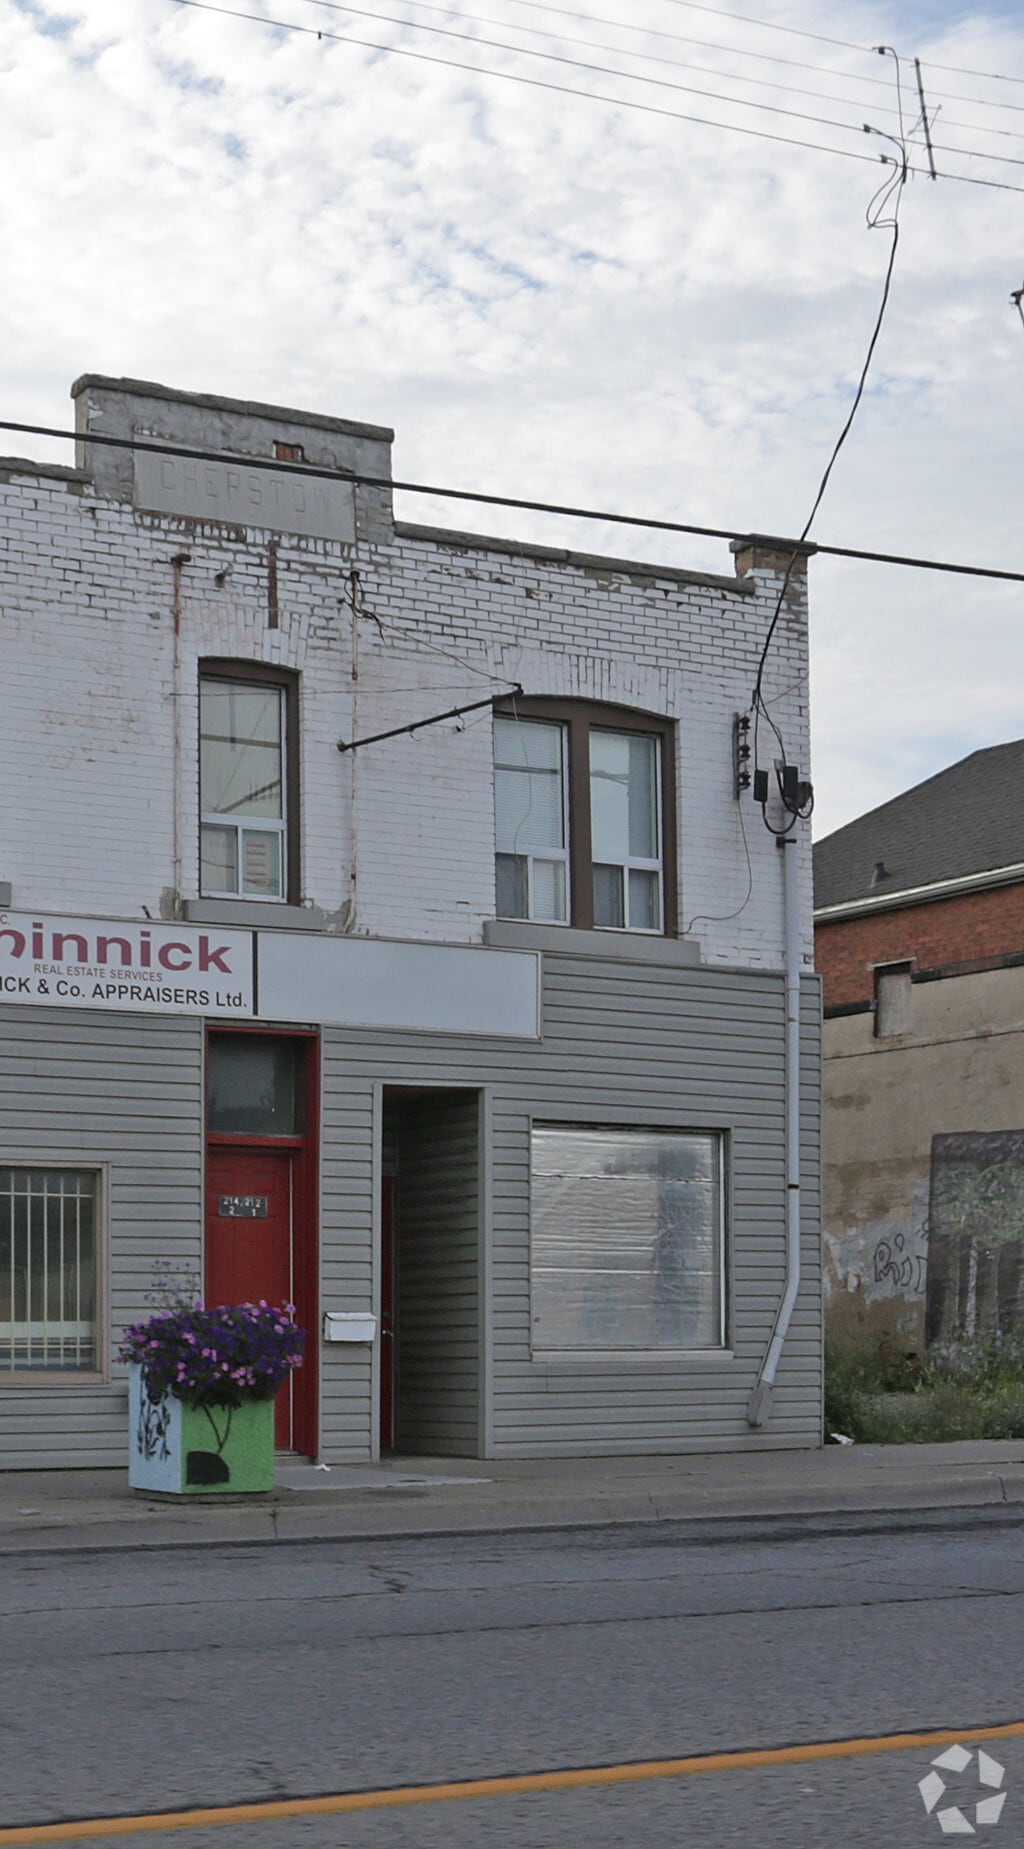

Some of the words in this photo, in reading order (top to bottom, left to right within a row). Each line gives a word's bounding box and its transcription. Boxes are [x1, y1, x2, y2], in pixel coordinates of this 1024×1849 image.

[0, 914, 12, 926] C.
[33, 963, 63, 976] REAL
[67, 965, 106, 979] ESTATE
[110, 968, 164, 983] SERVICES
[37, 979, 49, 995] &
[56, 980, 86, 998] Co.
[91, 983, 210, 1006] APPRAISERS
[215, 991, 247, 1008] Ltd.
